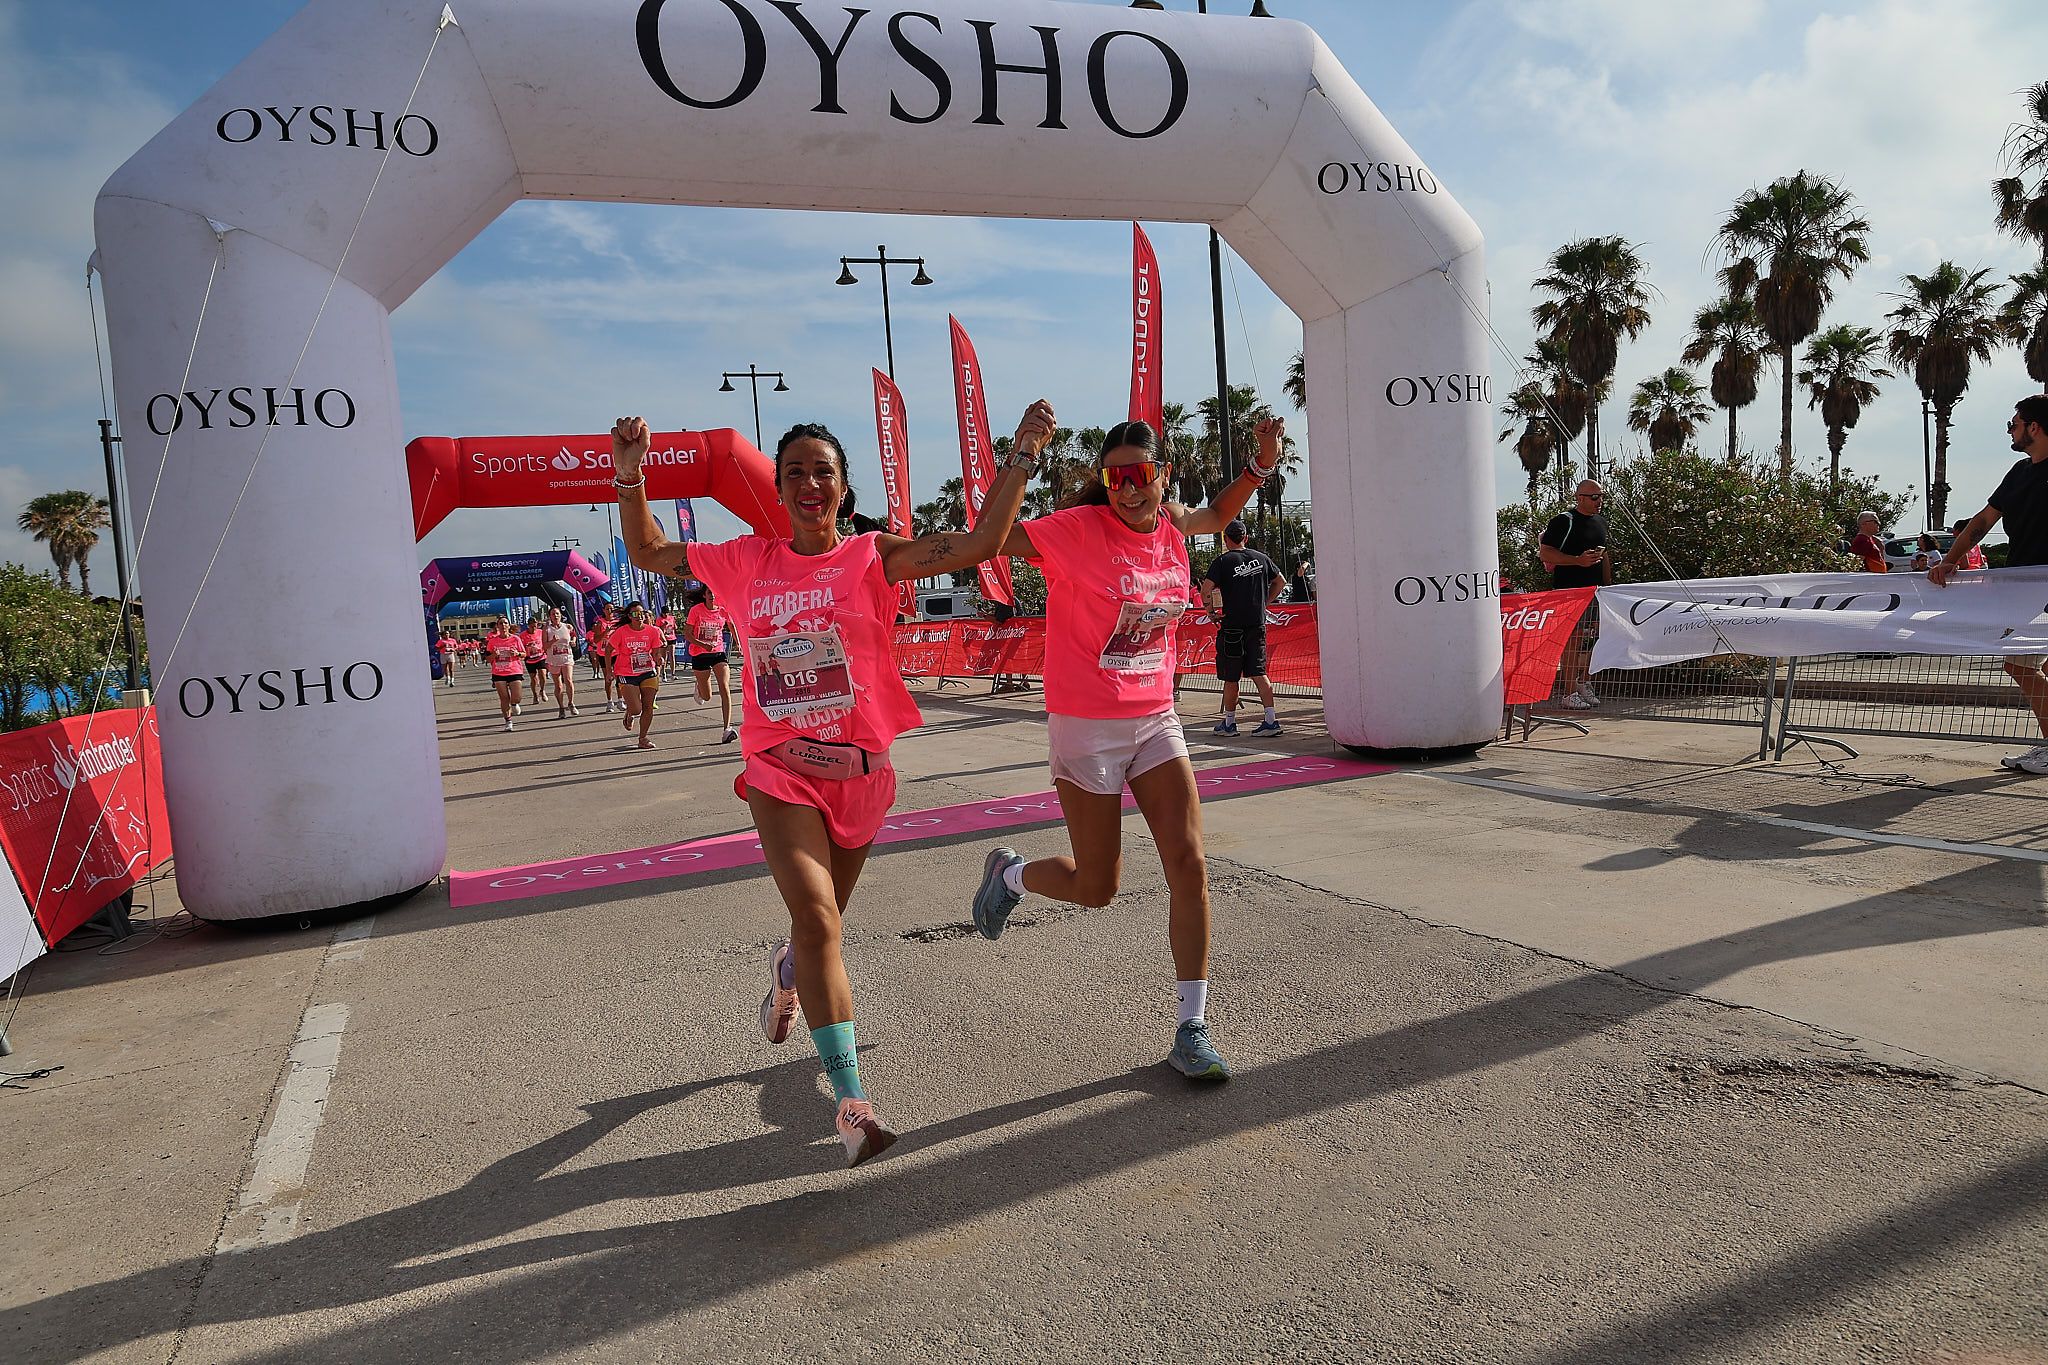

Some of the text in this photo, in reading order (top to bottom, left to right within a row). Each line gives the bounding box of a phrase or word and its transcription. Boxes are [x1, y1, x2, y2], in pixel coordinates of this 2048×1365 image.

[635, 0, 1190, 139] OYSHO
[216, 105, 439, 157] OYSHO
[1317, 162, 1438, 195] OYSHO
[1385, 374, 1493, 407] OYSHO
[146, 386, 356, 436] OYSHO
[472, 447, 697, 478] Sports Sander
[481, 559, 539, 568] octopus energy
[751, 586, 835, 619] CARRERA
[961, 625, 985, 642] Sports
[776, 643, 812, 656] ASTURIANA
[179, 660, 384, 719] OYSHO
[783, 669, 818, 687] 016
[766, 698, 787, 706] CARRERA
[818, 690, 842, 699] VALENCIA
[768, 707, 797, 717] OYSHO
[816, 723, 842, 742] 2026
[789, 747, 845, 765] LURBEL
[0, 732, 137, 820] Sports Santander
[489, 853, 704, 888] OYSHO
[823, 1051, 849, 1067] STAY
